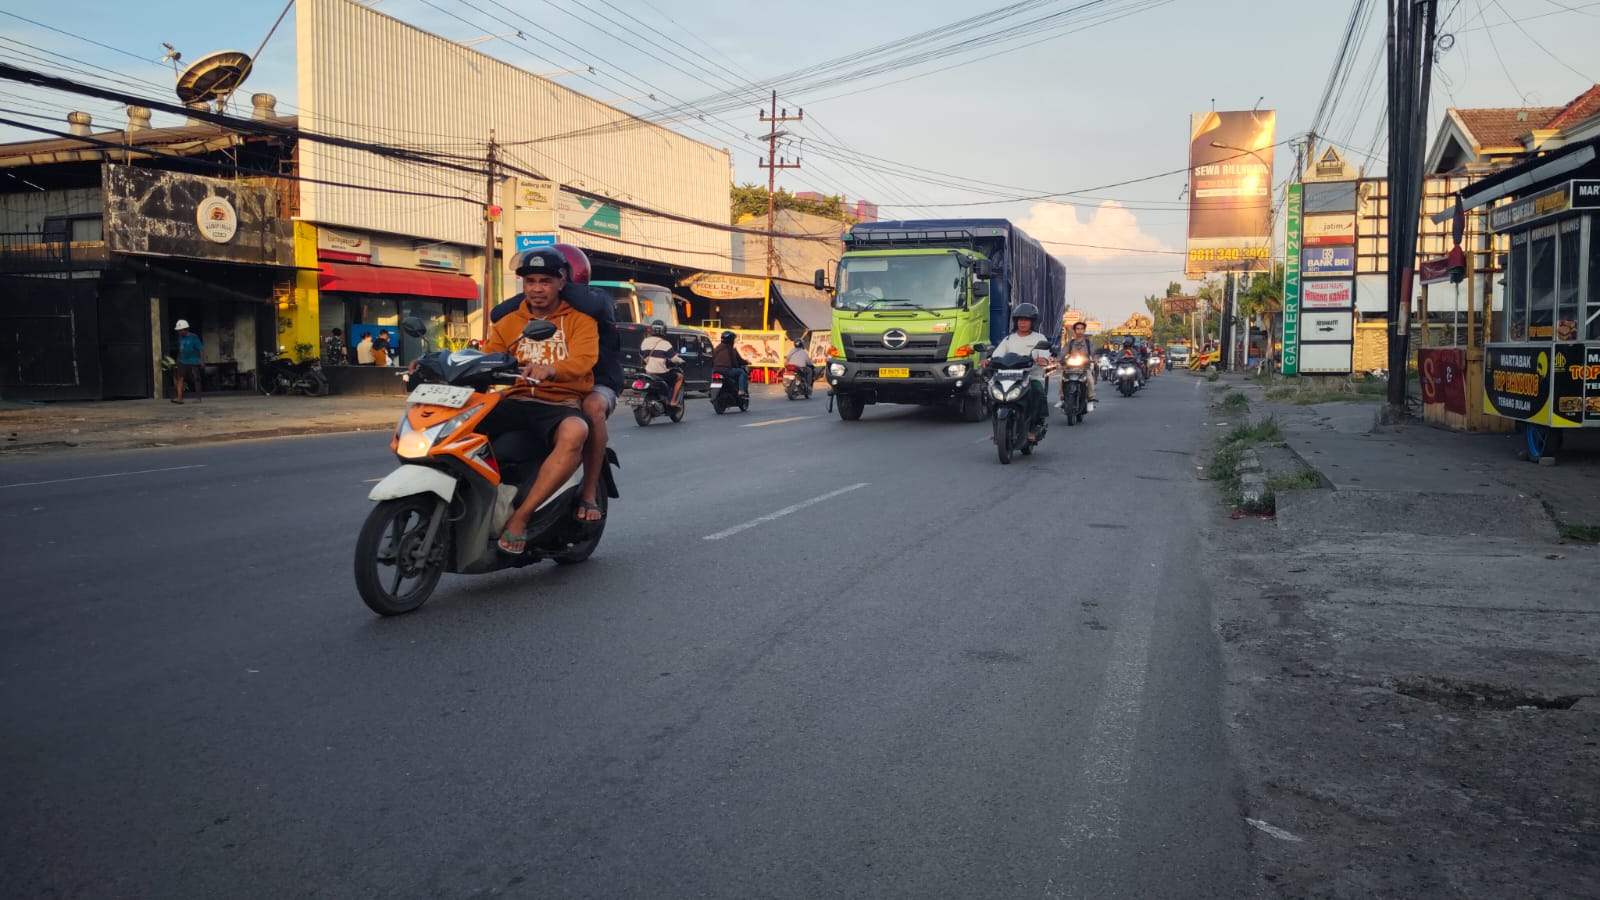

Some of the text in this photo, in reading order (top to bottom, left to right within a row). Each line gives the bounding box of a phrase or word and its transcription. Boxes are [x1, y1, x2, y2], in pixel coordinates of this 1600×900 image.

[1195, 165, 1220, 176] SEWA
[1579, 185, 1600, 196] MAR
[1308, 258, 1349, 267] BANK BRI
[1285, 193, 1300, 365] GALLERY ATM 24 JAM
[1500, 354, 1531, 368] MARTABAK
[1569, 365, 1600, 380] TOP
[1493, 370, 1540, 397] TOP BANDUNG
[1498, 397, 1531, 411] TERANG BULAN
